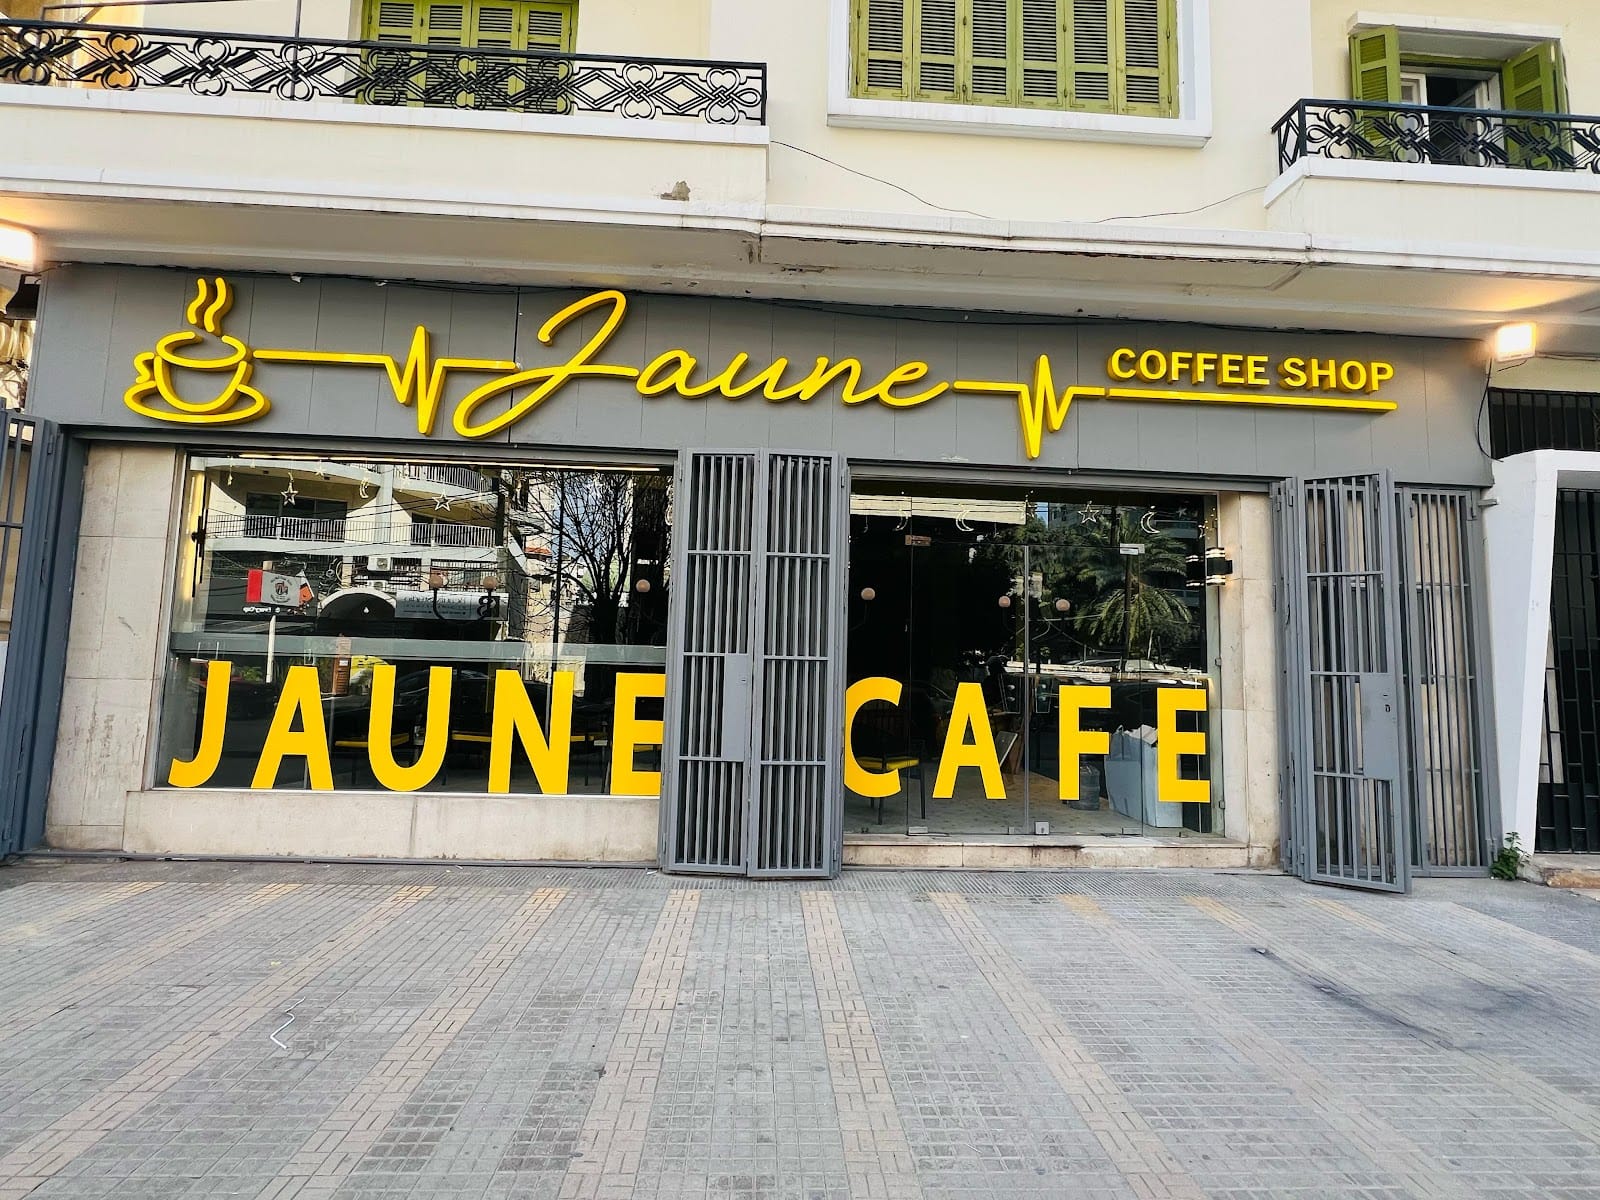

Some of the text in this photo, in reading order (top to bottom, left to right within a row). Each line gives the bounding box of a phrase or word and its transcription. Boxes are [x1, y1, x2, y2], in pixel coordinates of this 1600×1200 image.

[452, 289, 950, 439] Jaune
[1108, 347, 1395, 394] COFFEE SHOP
[168, 660, 1211, 805] JAUNE CAFE
